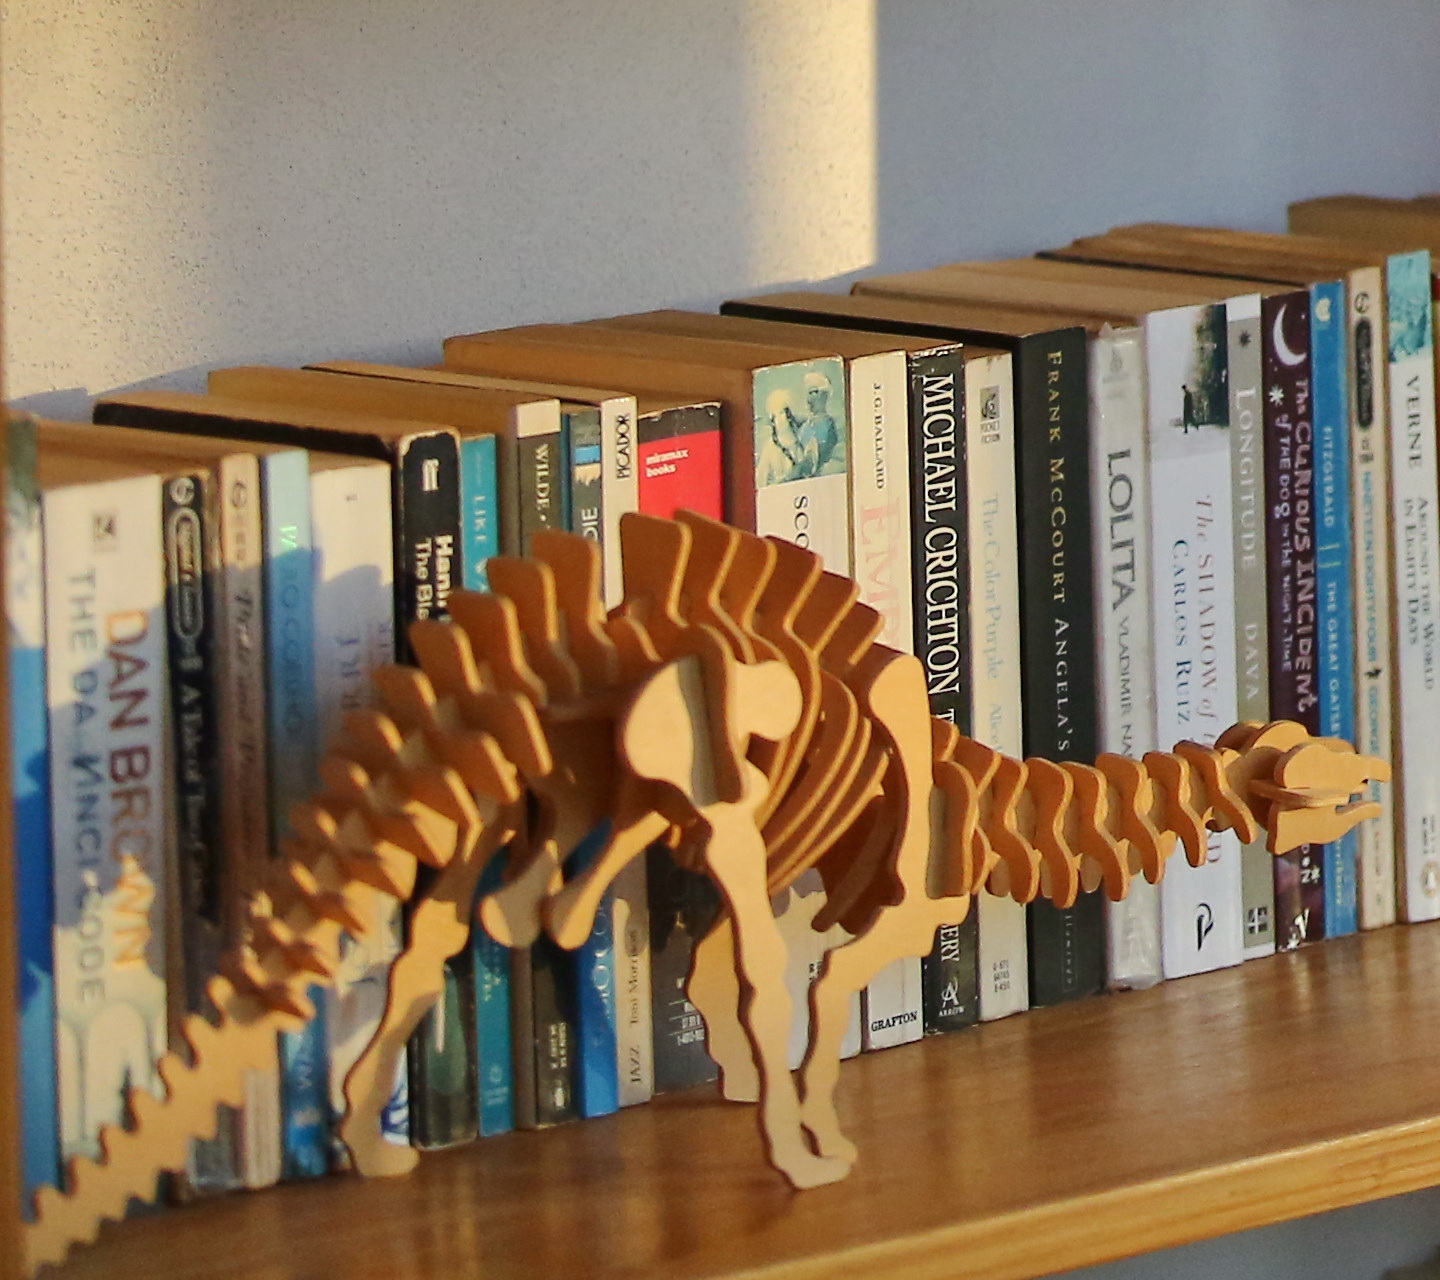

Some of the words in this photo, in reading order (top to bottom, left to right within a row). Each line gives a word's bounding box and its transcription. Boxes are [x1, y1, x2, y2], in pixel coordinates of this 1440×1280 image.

[1046, 350, 1063, 442] FRANK
[1295, 378, 1311, 418] The
[1405, 373, 1423, 469] VERNE
[535, 442, 551, 511] WILDE
[615, 413, 632, 480] PICADOR
[645, 447, 690, 466] miramax
[645, 463, 677, 478] books
[921, 372, 957, 524] MICHAEL
[1234, 388, 1258, 571] LONGITUDE
[1278, 435, 1292, 471] THE
[1320, 425, 1337, 528] FITZGERALD
[981, 493, 999, 533] The
[1107, 448, 1136, 611] LOLITA
[1195, 493, 1214, 539] The
[1417, 496, 1431, 578] AROUND
[414, 537, 432, 581] The
[981, 538, 1001, 602] Color
[1171, 539, 1190, 649] CARLOS
[66, 572, 97, 654] THE
[923, 526, 961, 696] CRICHTON
[1197, 553, 1219, 694] SHADOW
[1325, 580, 1339, 613] THE
[1406, 596, 1419, 646] DAYS
[105, 607, 151, 731] DAN
[981, 603, 1003, 681] Purple
[1118, 615, 1133, 717] VLADIMIR
[1244, 623, 1260, 702] DAVA
[1327, 618, 1341, 671] GREAT
[1423, 620, 1435, 691] WORLD
[71, 669, 100, 728] DA
[1054, 617, 1073, 752] ANGELA'S
[1199, 697, 1218, 719] of
[1329, 676, 1342, 739] GATSB
[108, 744, 155, 971] BROWN
[74, 889, 107, 1006] CODE
[870, 1009, 919, 1033] GRAFTON
[629, 1042, 642, 1084] JAZZ
